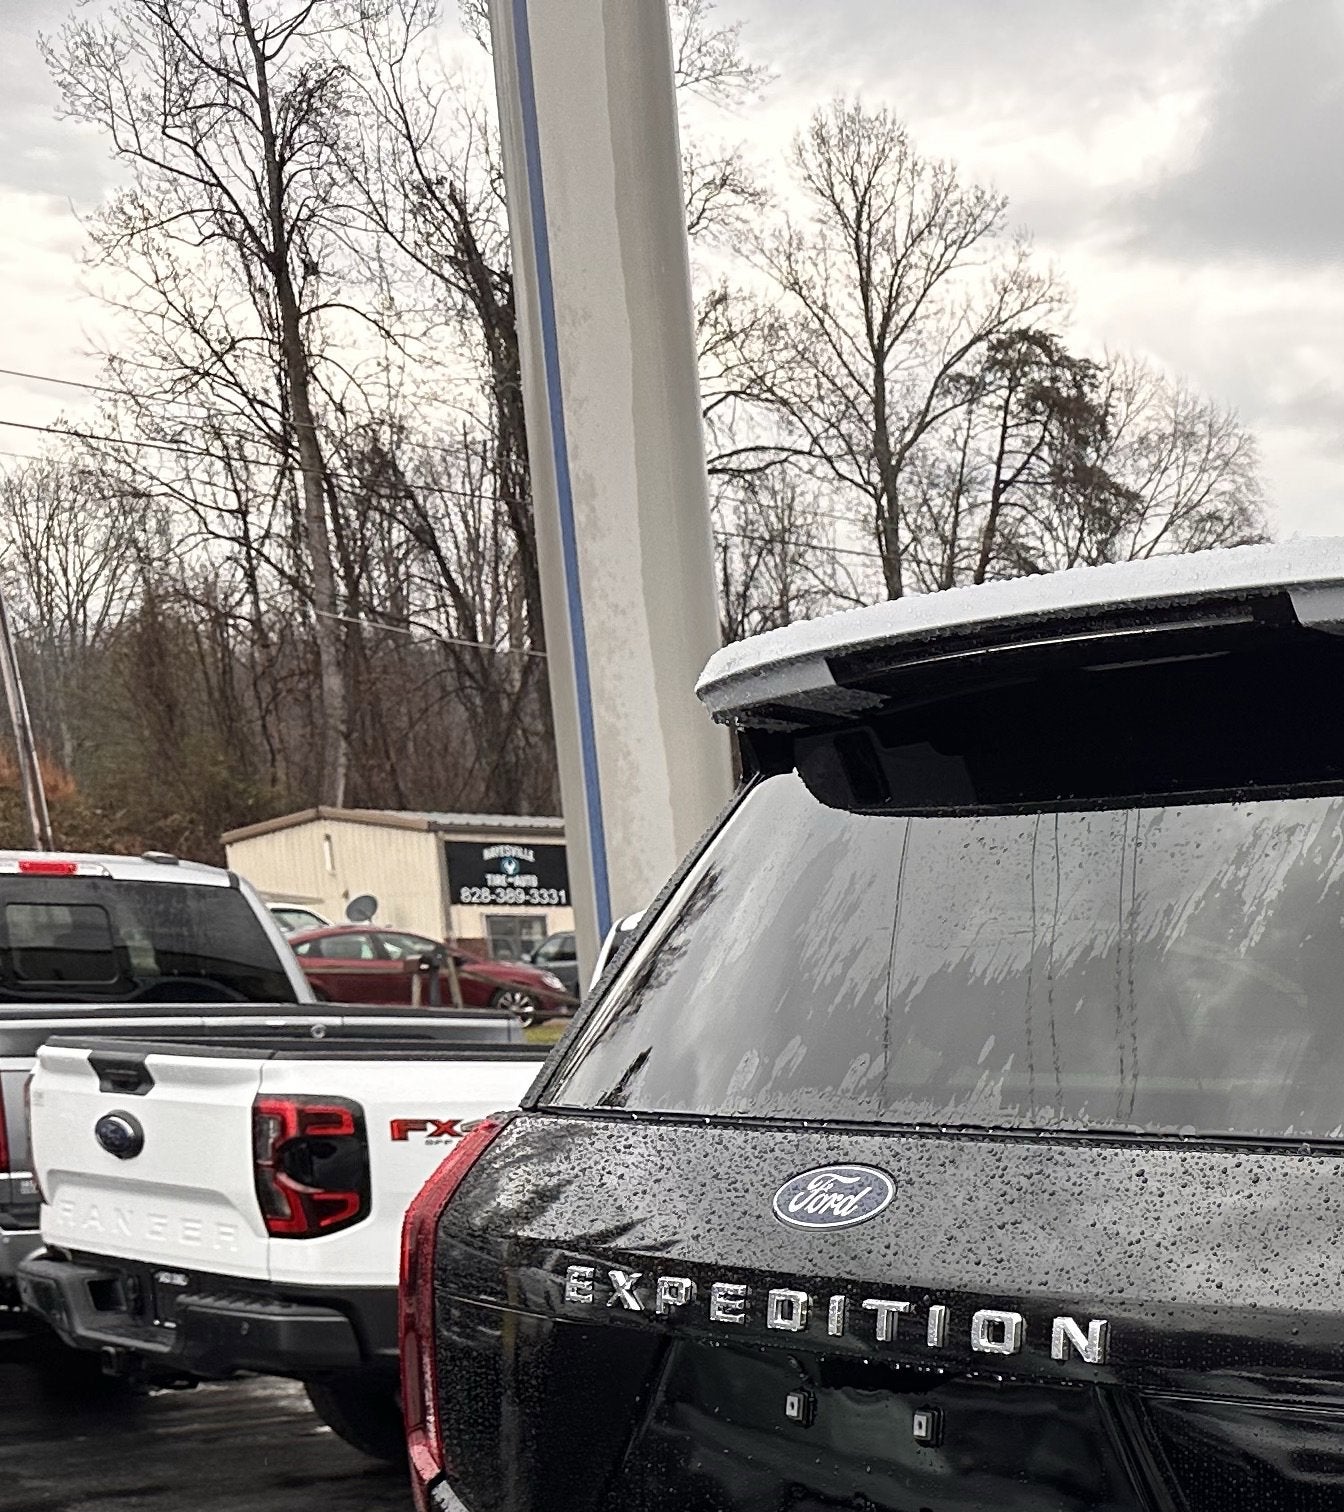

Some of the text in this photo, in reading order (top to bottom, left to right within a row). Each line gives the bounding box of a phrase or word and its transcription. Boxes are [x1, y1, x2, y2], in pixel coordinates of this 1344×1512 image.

[460, 886, 567, 904] 828-389-3331
[788, 1172, 872, 1218] Ford
[59, 1201, 238, 1251] RANGER
[565, 1265, 1111, 1365] EXPEDITION
